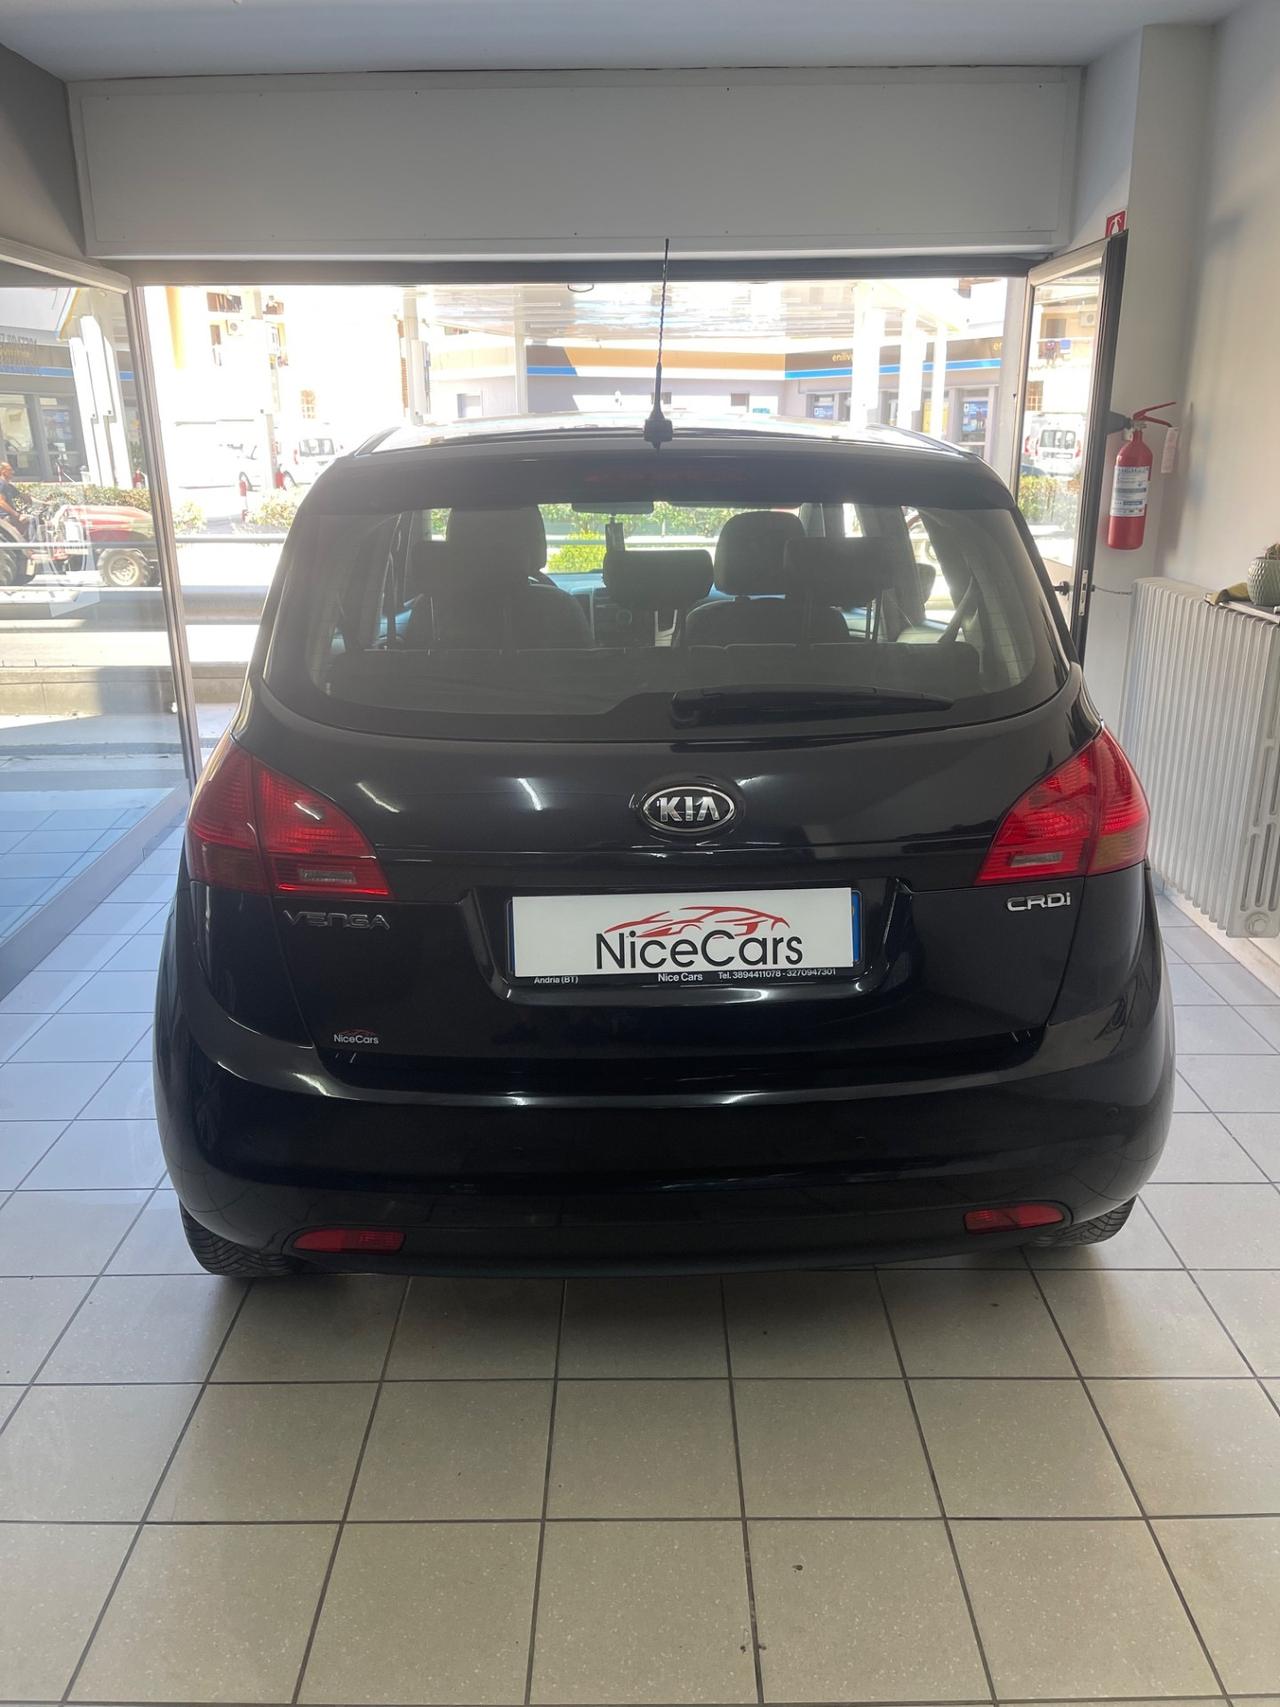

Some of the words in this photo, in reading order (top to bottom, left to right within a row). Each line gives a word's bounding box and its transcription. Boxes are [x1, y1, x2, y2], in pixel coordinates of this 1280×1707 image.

[658, 796, 720, 822] KIA
[596, 929, 803, 970] NiceCars
[534, 975, 560, 984] Andria
[658, 972, 680, 982] Nice
[681, 971, 704, 982] Cars
[718, 971, 732, 980] Tel.
[732, 969, 782, 980] 3894411078
[333, 1033, 379, 1045] NiceCars
